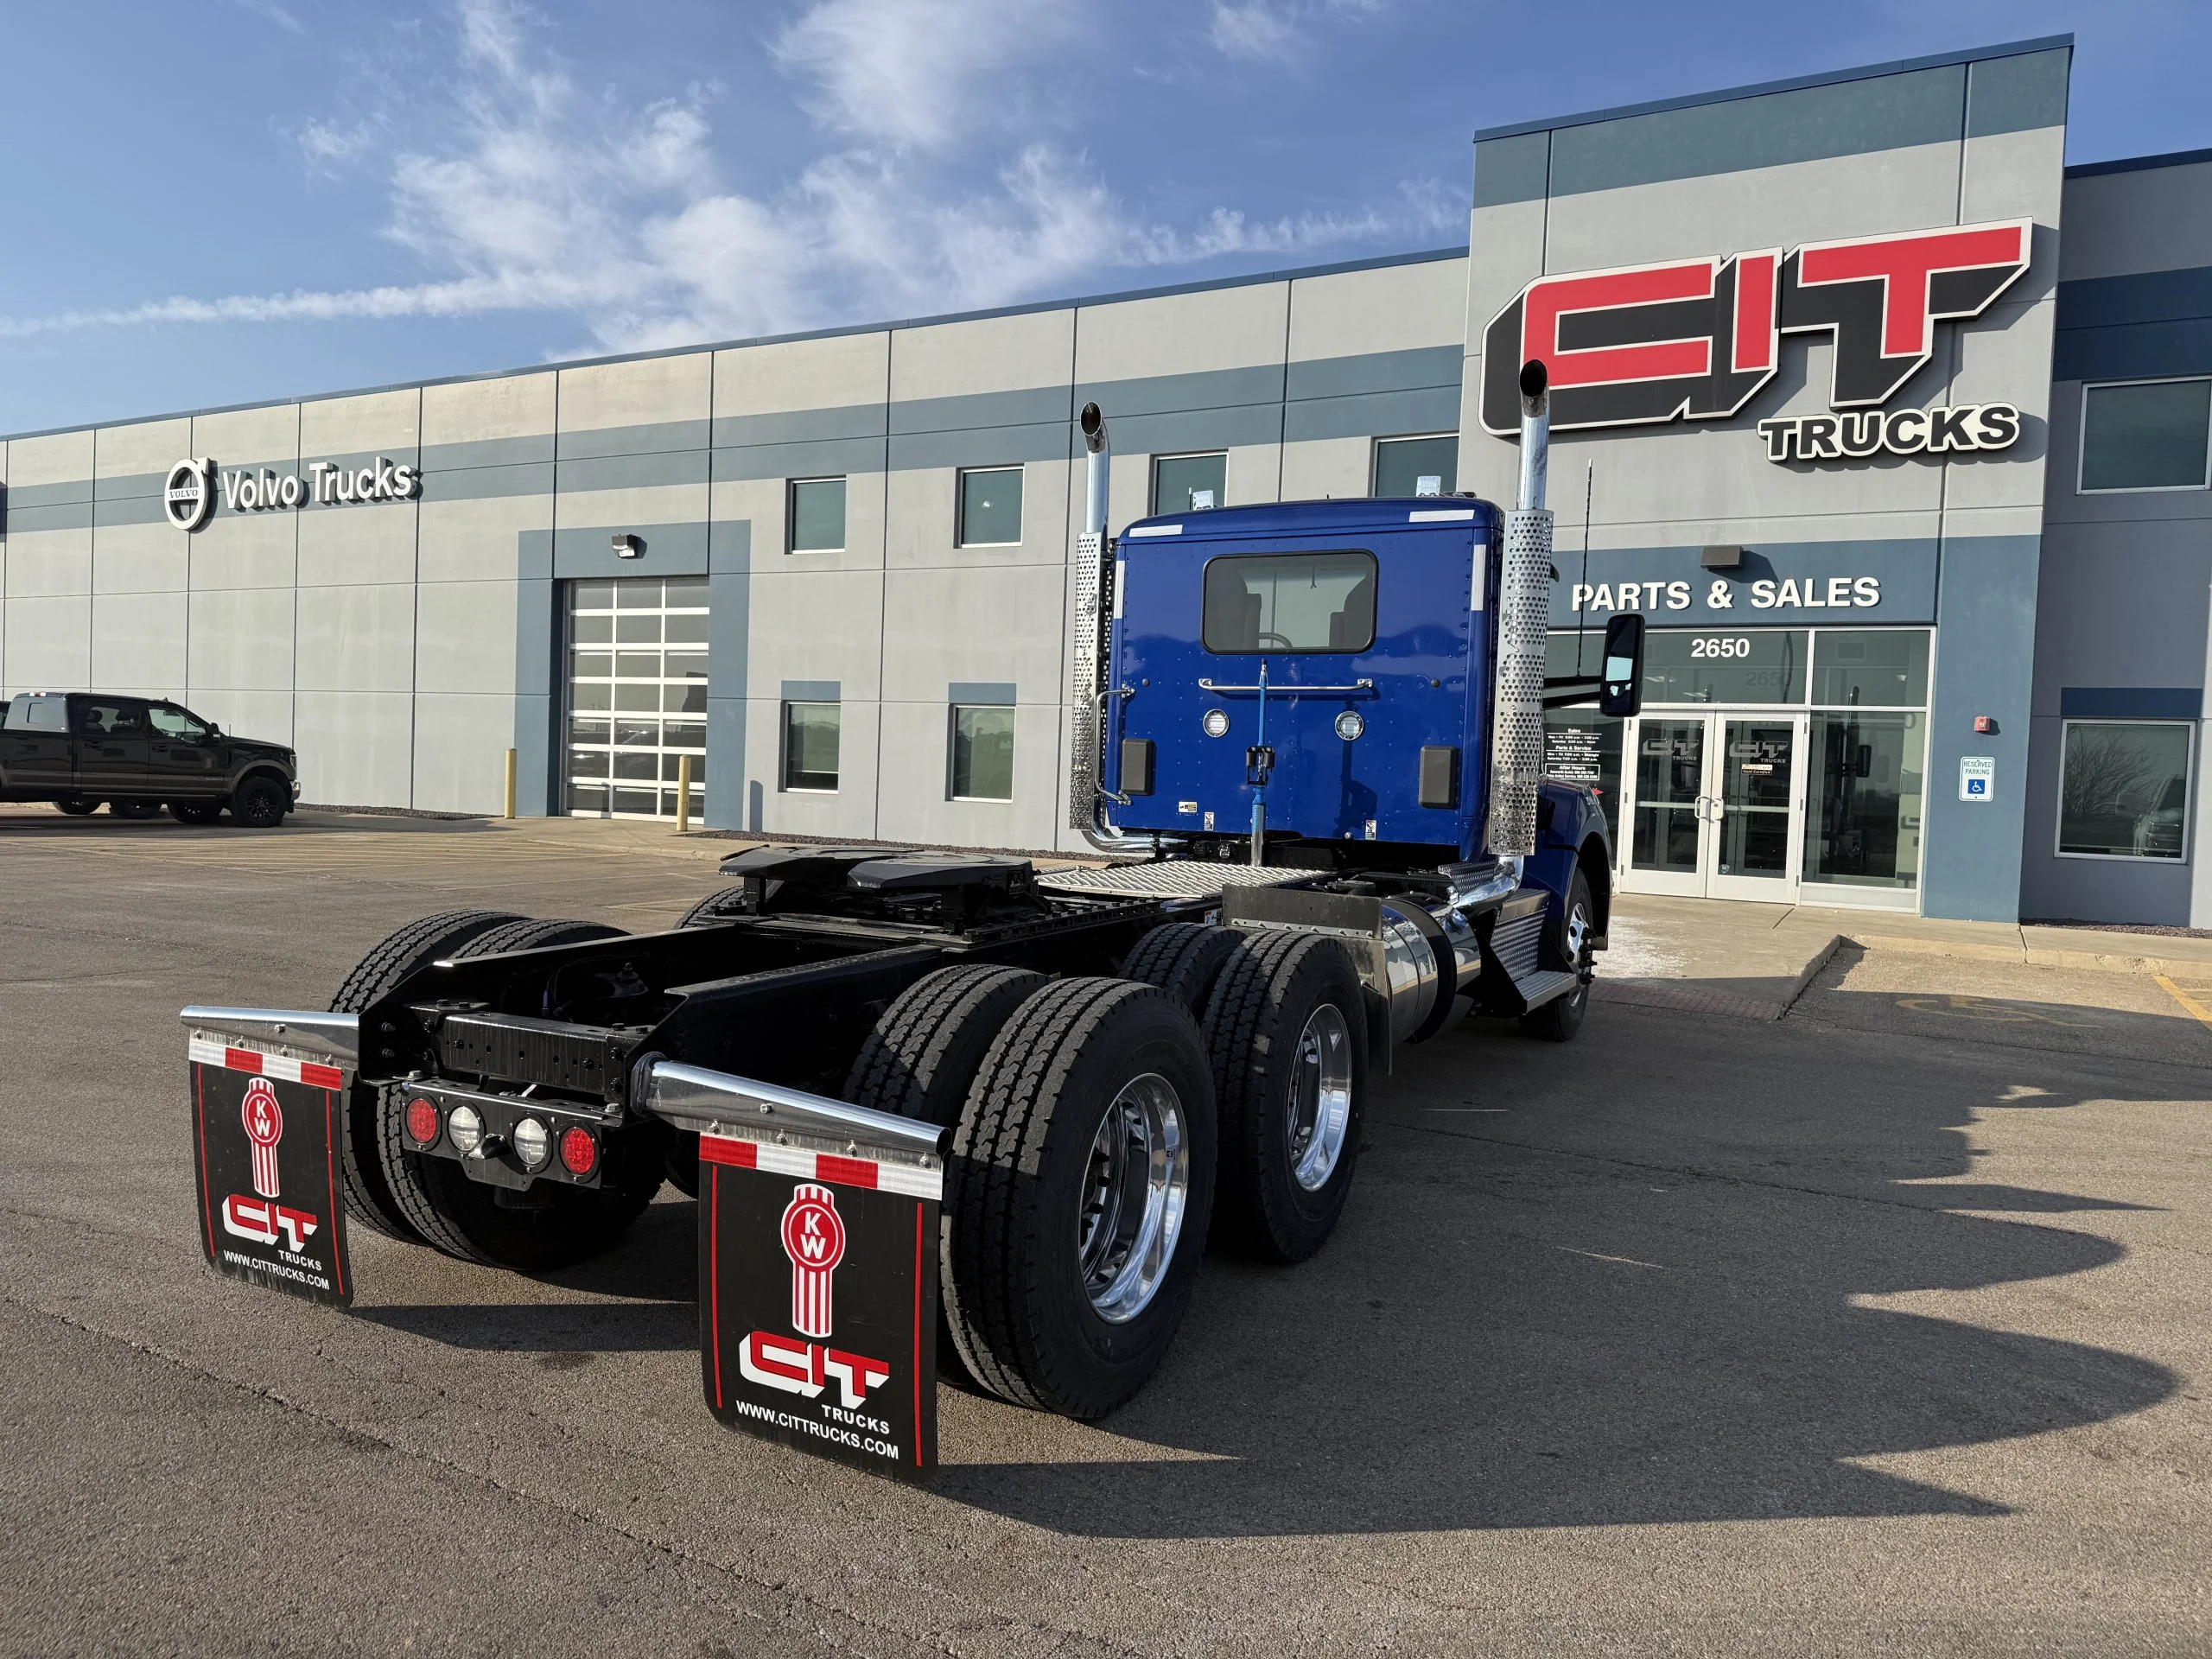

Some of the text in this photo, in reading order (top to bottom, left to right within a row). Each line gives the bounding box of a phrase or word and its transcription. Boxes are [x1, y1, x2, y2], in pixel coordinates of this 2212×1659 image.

[1478, 217, 2033, 435] CIT
[1757, 402, 2019, 462] TRUCKS
[169, 489, 199, 499] VOLVO
[222, 456, 414, 510] Volvo Trucks
[1572, 577, 1880, 612] PARTS & SALES
[1691, 639, 1751, 658] 2650
[1643, 739, 1700, 756] CIT
[1729, 741, 1788, 758] CIT
[222, 1193, 318, 1253] CIT
[223, 1249, 330, 1290] WWW.CITTRUCKS.COM
[277, 1249, 322, 1271] TRUCKS
[739, 1331, 890, 1409] CIT
[735, 1400, 899, 1460] WWW.CITTRUCKS.COM
[821, 1404, 891, 1434] TRUCKS
